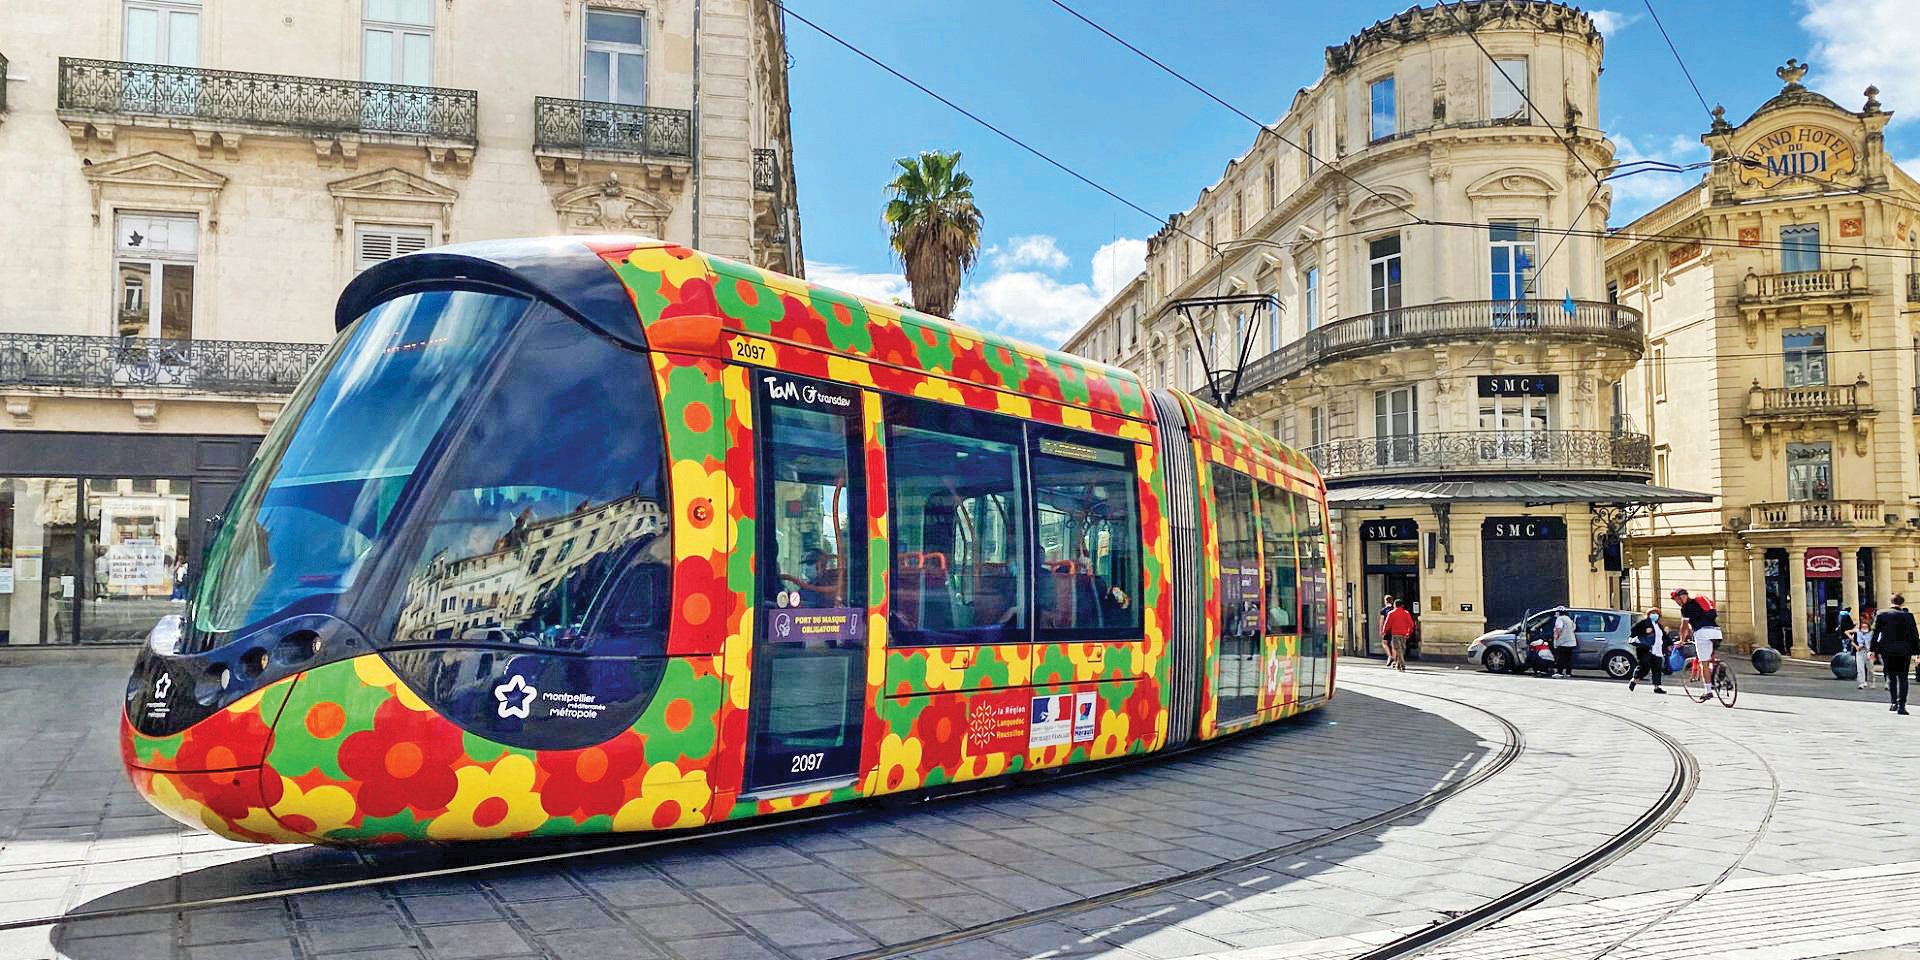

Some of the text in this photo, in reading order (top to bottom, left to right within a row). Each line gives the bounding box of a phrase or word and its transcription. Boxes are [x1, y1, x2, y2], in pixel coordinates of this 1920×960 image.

[1743, 129, 1849, 168] RAND HOTEL
[1788, 143, 1803, 152] DU
[1767, 150, 1826, 177] MIDI
[736, 342, 766, 360] 2097
[1490, 378, 1530, 392] SMC
[817, 392, 851, 407] transdev
[1369, 526, 1397, 538] SMC
[1496, 524, 1535, 537] SMC
